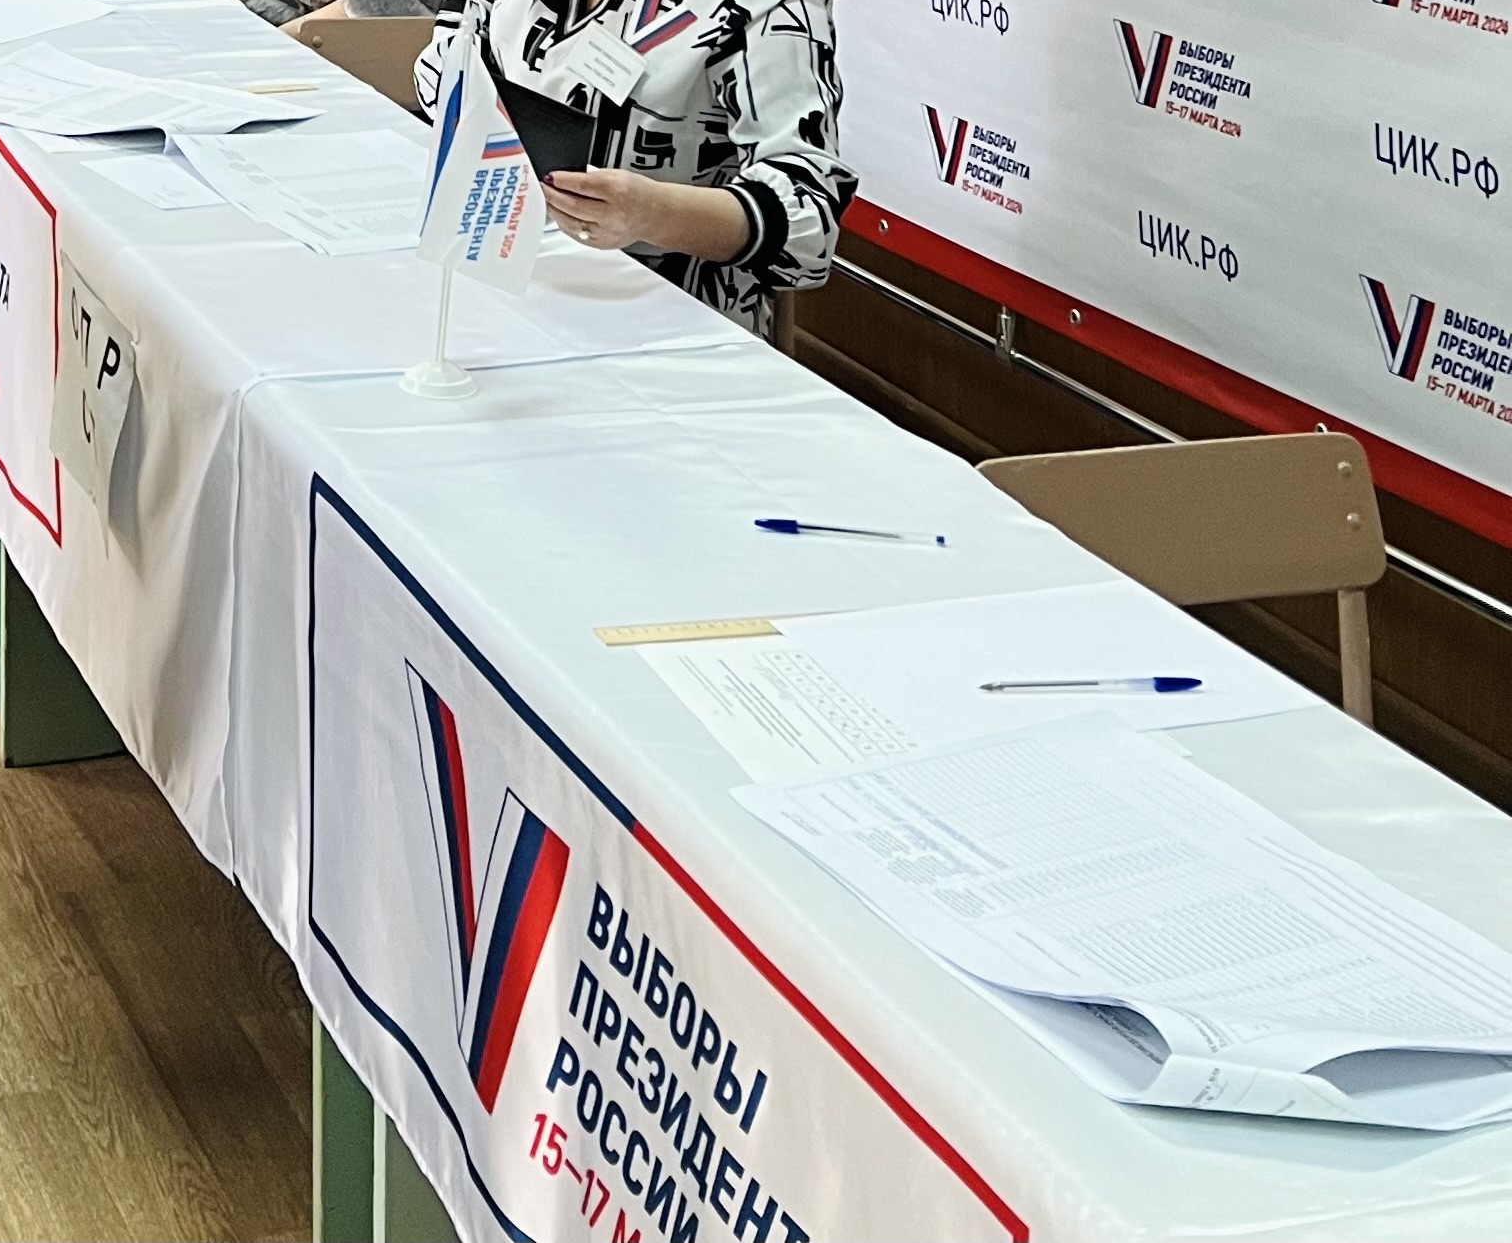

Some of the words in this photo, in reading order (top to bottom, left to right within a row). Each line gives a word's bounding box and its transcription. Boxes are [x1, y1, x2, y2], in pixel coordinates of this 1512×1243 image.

[1174, 61, 1250, 98] ПРЕЗИДЕНТА
[1179, 40, 1234, 70] ВЫБОРЫ
[1169, 81, 1218, 109] РОССИИ
[1375, 123, 1499, 199] ЦИК.РФ
[1138, 210, 1238, 282] ЦИК.РФ
[1431, 353, 1494, 392] РОССИИ
[587, 881, 768, 1134] ВЫБОРЫ
[529, 1113, 610, 1227] 15–17
